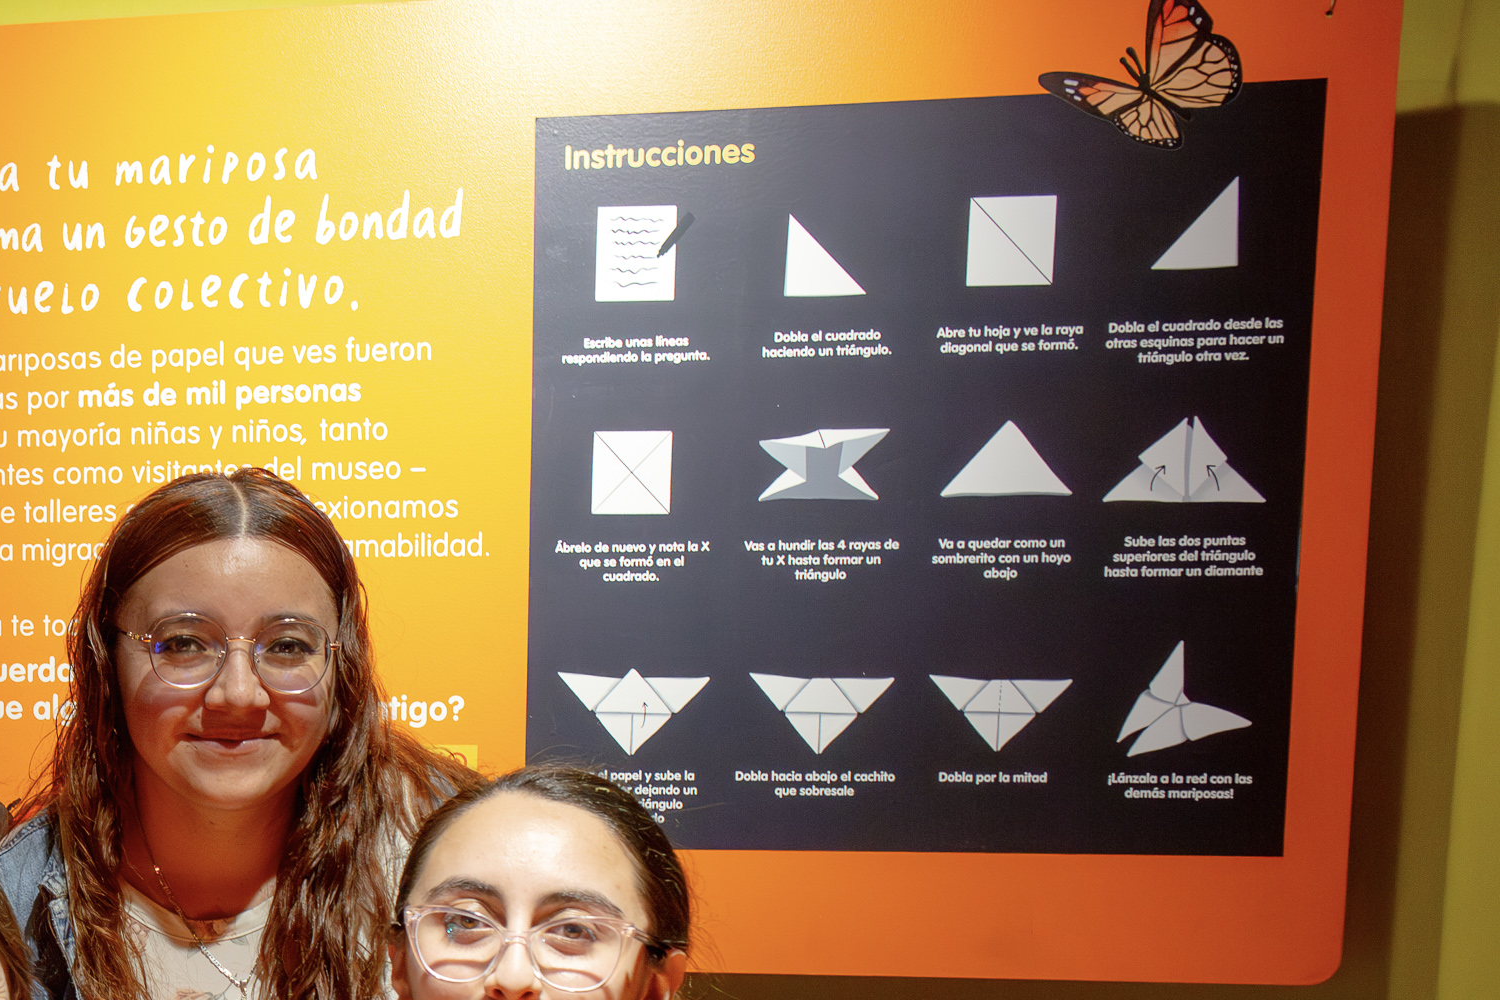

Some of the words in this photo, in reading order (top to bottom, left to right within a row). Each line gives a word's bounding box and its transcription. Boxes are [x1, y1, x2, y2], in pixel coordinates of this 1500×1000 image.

[564, 139, 755, 170] Instrucciones
[47, 155, 88, 190] tu
[115, 145, 317, 186] mariposa
[63, 222, 105, 251] un
[249, 195, 295, 245] de
[316, 187, 463, 245] bondad
[936, 326, 966, 339] Abre
[967, 326, 982, 338] tu
[984, 324, 1011, 340] hoja
[1012, 326, 1022, 340] y
[1023, 326, 1039, 337] ve
[1040, 323, 1053, 336] la
[1055, 325, 1084, 338] raya
[1108, 320, 1146, 334] Dobla
[1146, 320, 1160, 333] el
[1161, 318, 1222, 333] cuadrado
[1223, 316, 1263, 331] desde
[1264, 316, 1284, 329] las
[583, 336, 623, 350] Escribe
[625, 337, 654, 348] unas
[655, 334, 689, 348] líneas
[774, 330, 809, 343] Dobla
[810, 329, 823, 343] el
[824, 328, 882, 342] cuadrado
[1105, 337, 1138, 350] otras
[1139, 335, 1195, 351] esquinas
[1195, 336, 1227, 350] para
[1228, 333, 1267, 346] hacer
[1267, 334, 1285, 345] un
[110, 344, 142, 368] de
[152, 340, 224, 373] papel
[234, 346, 283, 371] que
[293, 344, 336, 364] ves
[345, 336, 431, 362] fueron
[761, 345, 816, 358] haciendo
[818, 347, 834, 357] un
[835, 343, 892, 358] triángulo.
[939, 340, 993, 356] diagonal
[994, 342, 1019, 355] que
[1020, 341, 1036, 352] se
[1037, 337, 1079, 351] formó.
[561, 350, 639, 367] respondiendo
[640, 350, 653, 363] la
[654, 349, 711, 365] pregunta.
[1136, 350, 1194, 366] triángulo
[1194, 350, 1223, 362] otra
[1223, 351, 1250, 361] vez.
[28, 391, 69, 415] por
[78, 382, 134, 408] más
[143, 381, 176, 406] de
[187, 380, 225, 405] mil
[236, 383, 361, 410] personas
[18, 428, 120, 452] mayoría
[131, 426, 200, 445] niñas
[210, 425, 222, 449] y
[232, 424, 306, 445] niños,
[320, 417, 388, 441] tanto
[53, 466, 123, 484] como
[263, 455, 301, 481] del
[312, 461, 401, 480] museo
[24, 499, 116, 523] talleres
[554, 539, 592, 554] Ábrelo
[594, 541, 610, 553] de
[611, 543, 647, 553] nuevo
[648, 543, 657, 556] y
[658, 541, 686, 553] nota
[687, 540, 699, 553] la
[700, 540, 710, 552] X
[744, 540, 765, 552] Vas
[767, 542, 776, 552] a
[778, 538, 816, 552] hundir
[818, 538, 835, 551] las
[836, 539, 847, 551] 4
[848, 540, 882, 553] rayas
[883, 537, 900, 551] de
[938, 537, 955, 550] Va
[956, 540, 966, 550] a
[967, 536, 1012, 552] quedar
[1013, 538, 1048, 549] como
[1049, 538, 1066, 549] un
[1123, 535, 1156, 548] Sube
[1157, 534, 1177, 547] las
[1177, 534, 1202, 547] dos
[1202, 534, 1247, 550] puntas
[22, 538, 105, 567] migrac
[760, 554, 774, 566] tu
[776, 554, 786, 566] X
[787, 553, 821, 566] hasta
[822, 553, 864, 566] formar
[865, 555, 882, 565] un
[931, 551, 996, 565] sombrerito
[998, 554, 1021, 564] con
[1022, 554, 1039, 564] un
[1040, 551, 1072, 566] hoyo
[1112, 550, 1177, 565] superiores
[1177, 549, 1199, 562] del
[1199, 549, 1257, 564] triángulo
[579, 558, 602, 571] que
[603, 558, 617, 568] se
[618, 555, 654, 568] formó
[655, 557, 671, 567] en
[673, 554, 685, 567] el
[602, 569, 660, 582] cuadrado.
[794, 568, 847, 583] triángulo
[983, 566, 1018, 581] abajo
[1103, 565, 1139, 578] hasta
[1139, 565, 1185, 578] formar
[1185, 567, 1203, 578] un
[1203, 564, 1264, 577] diamante
[11, 614, 35, 637] te
[609, 769, 642, 784] papel
[644, 772, 652, 784] y
[654, 769, 682, 782] sube
[684, 769, 695, 782] la
[735, 769, 769, 782] Dobla
[771, 769, 803, 782] hacia
[804, 770, 838, 785] abajo
[840, 770, 852, 782] el
[853, 770, 896, 783] cachito
[938, 770, 974, 783] Dobla
[975, 773, 997, 786] por
[998, 771, 1011, 784] la
[1012, 771, 1048, 784] mitad
[1107, 771, 1158, 786] ¡Lánzala
[1159, 774, 1170, 785] a
[1171, 772, 1184, 785] la
[1185, 772, 1208, 785] red
[1209, 775, 1233, 785] con
[1234, 772, 1253, 785] las
[634, 783, 680, 798] dejando
[682, 786, 698, 796] un
[774, 787, 797, 799] que
[799, 784, 855, 797] sobresale
[1123, 786, 1166, 799] demás
[1167, 787, 1235, 802] mariposas!
